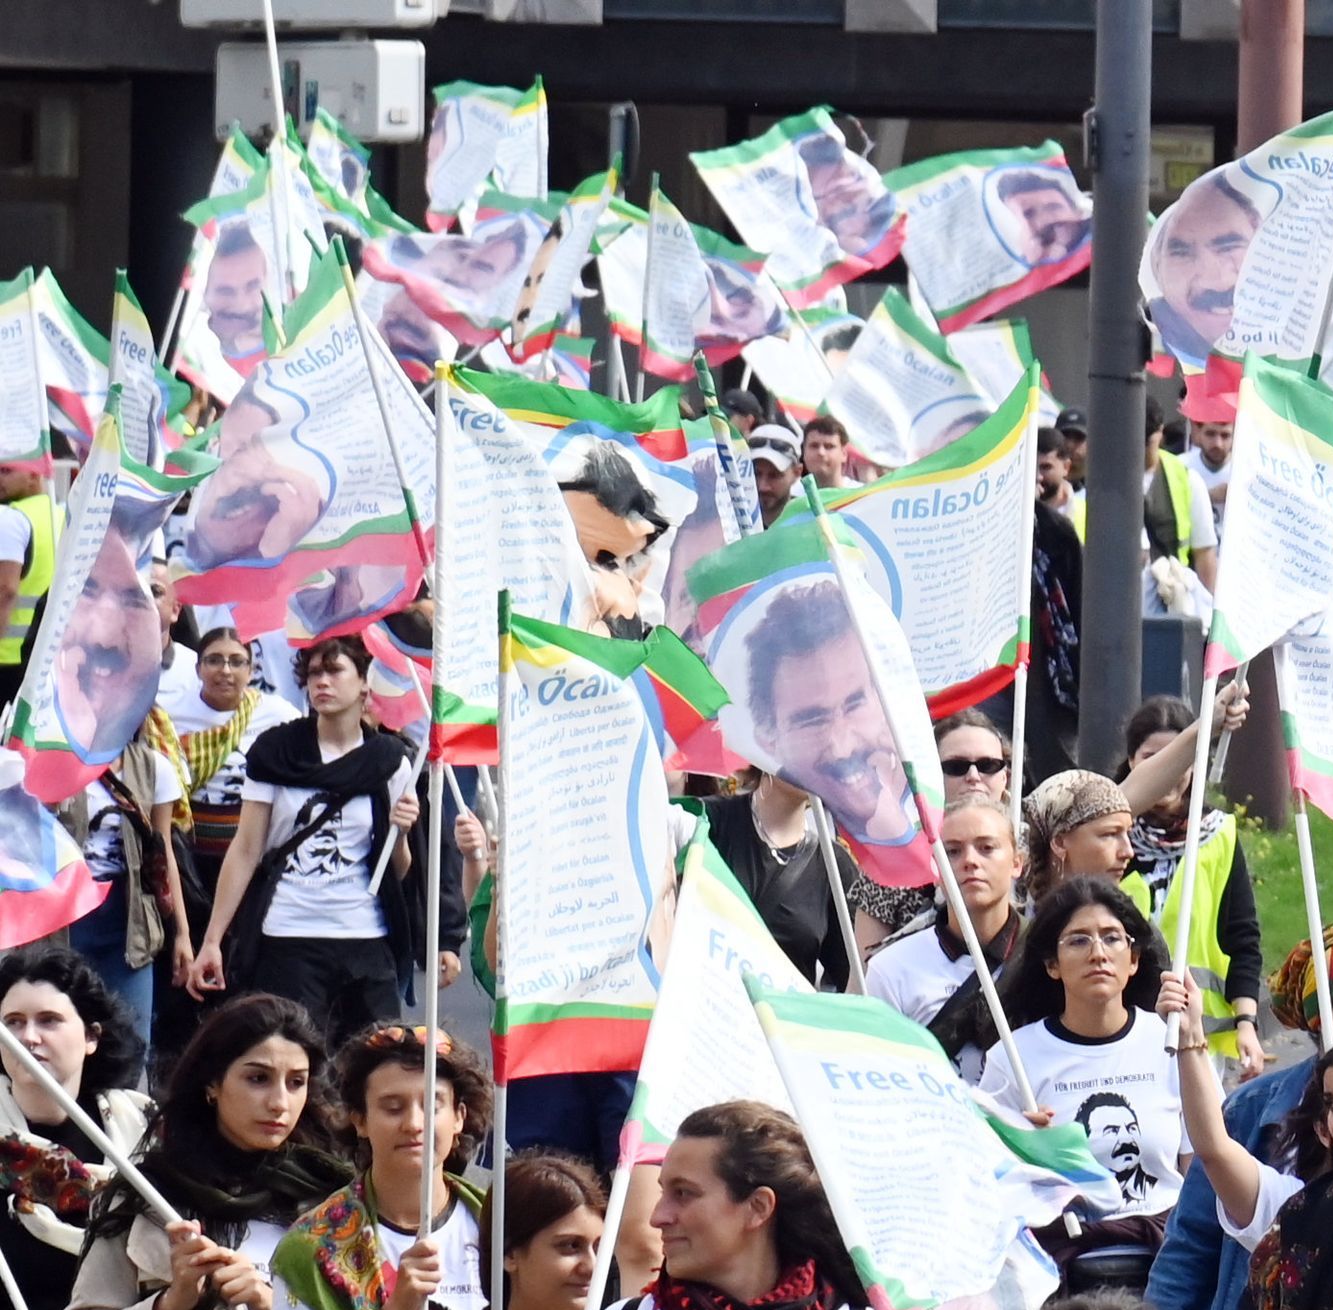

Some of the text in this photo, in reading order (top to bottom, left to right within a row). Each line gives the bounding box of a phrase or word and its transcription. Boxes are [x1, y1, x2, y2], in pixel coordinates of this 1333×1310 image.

[118, 330, 147, 363] Free
[903, 350, 956, 386] Öcalan
[820, 1061, 914, 1091] Free
[1054, 1072, 1156, 1093] FÜR FREIHEIT UND DEMOKRATIE
